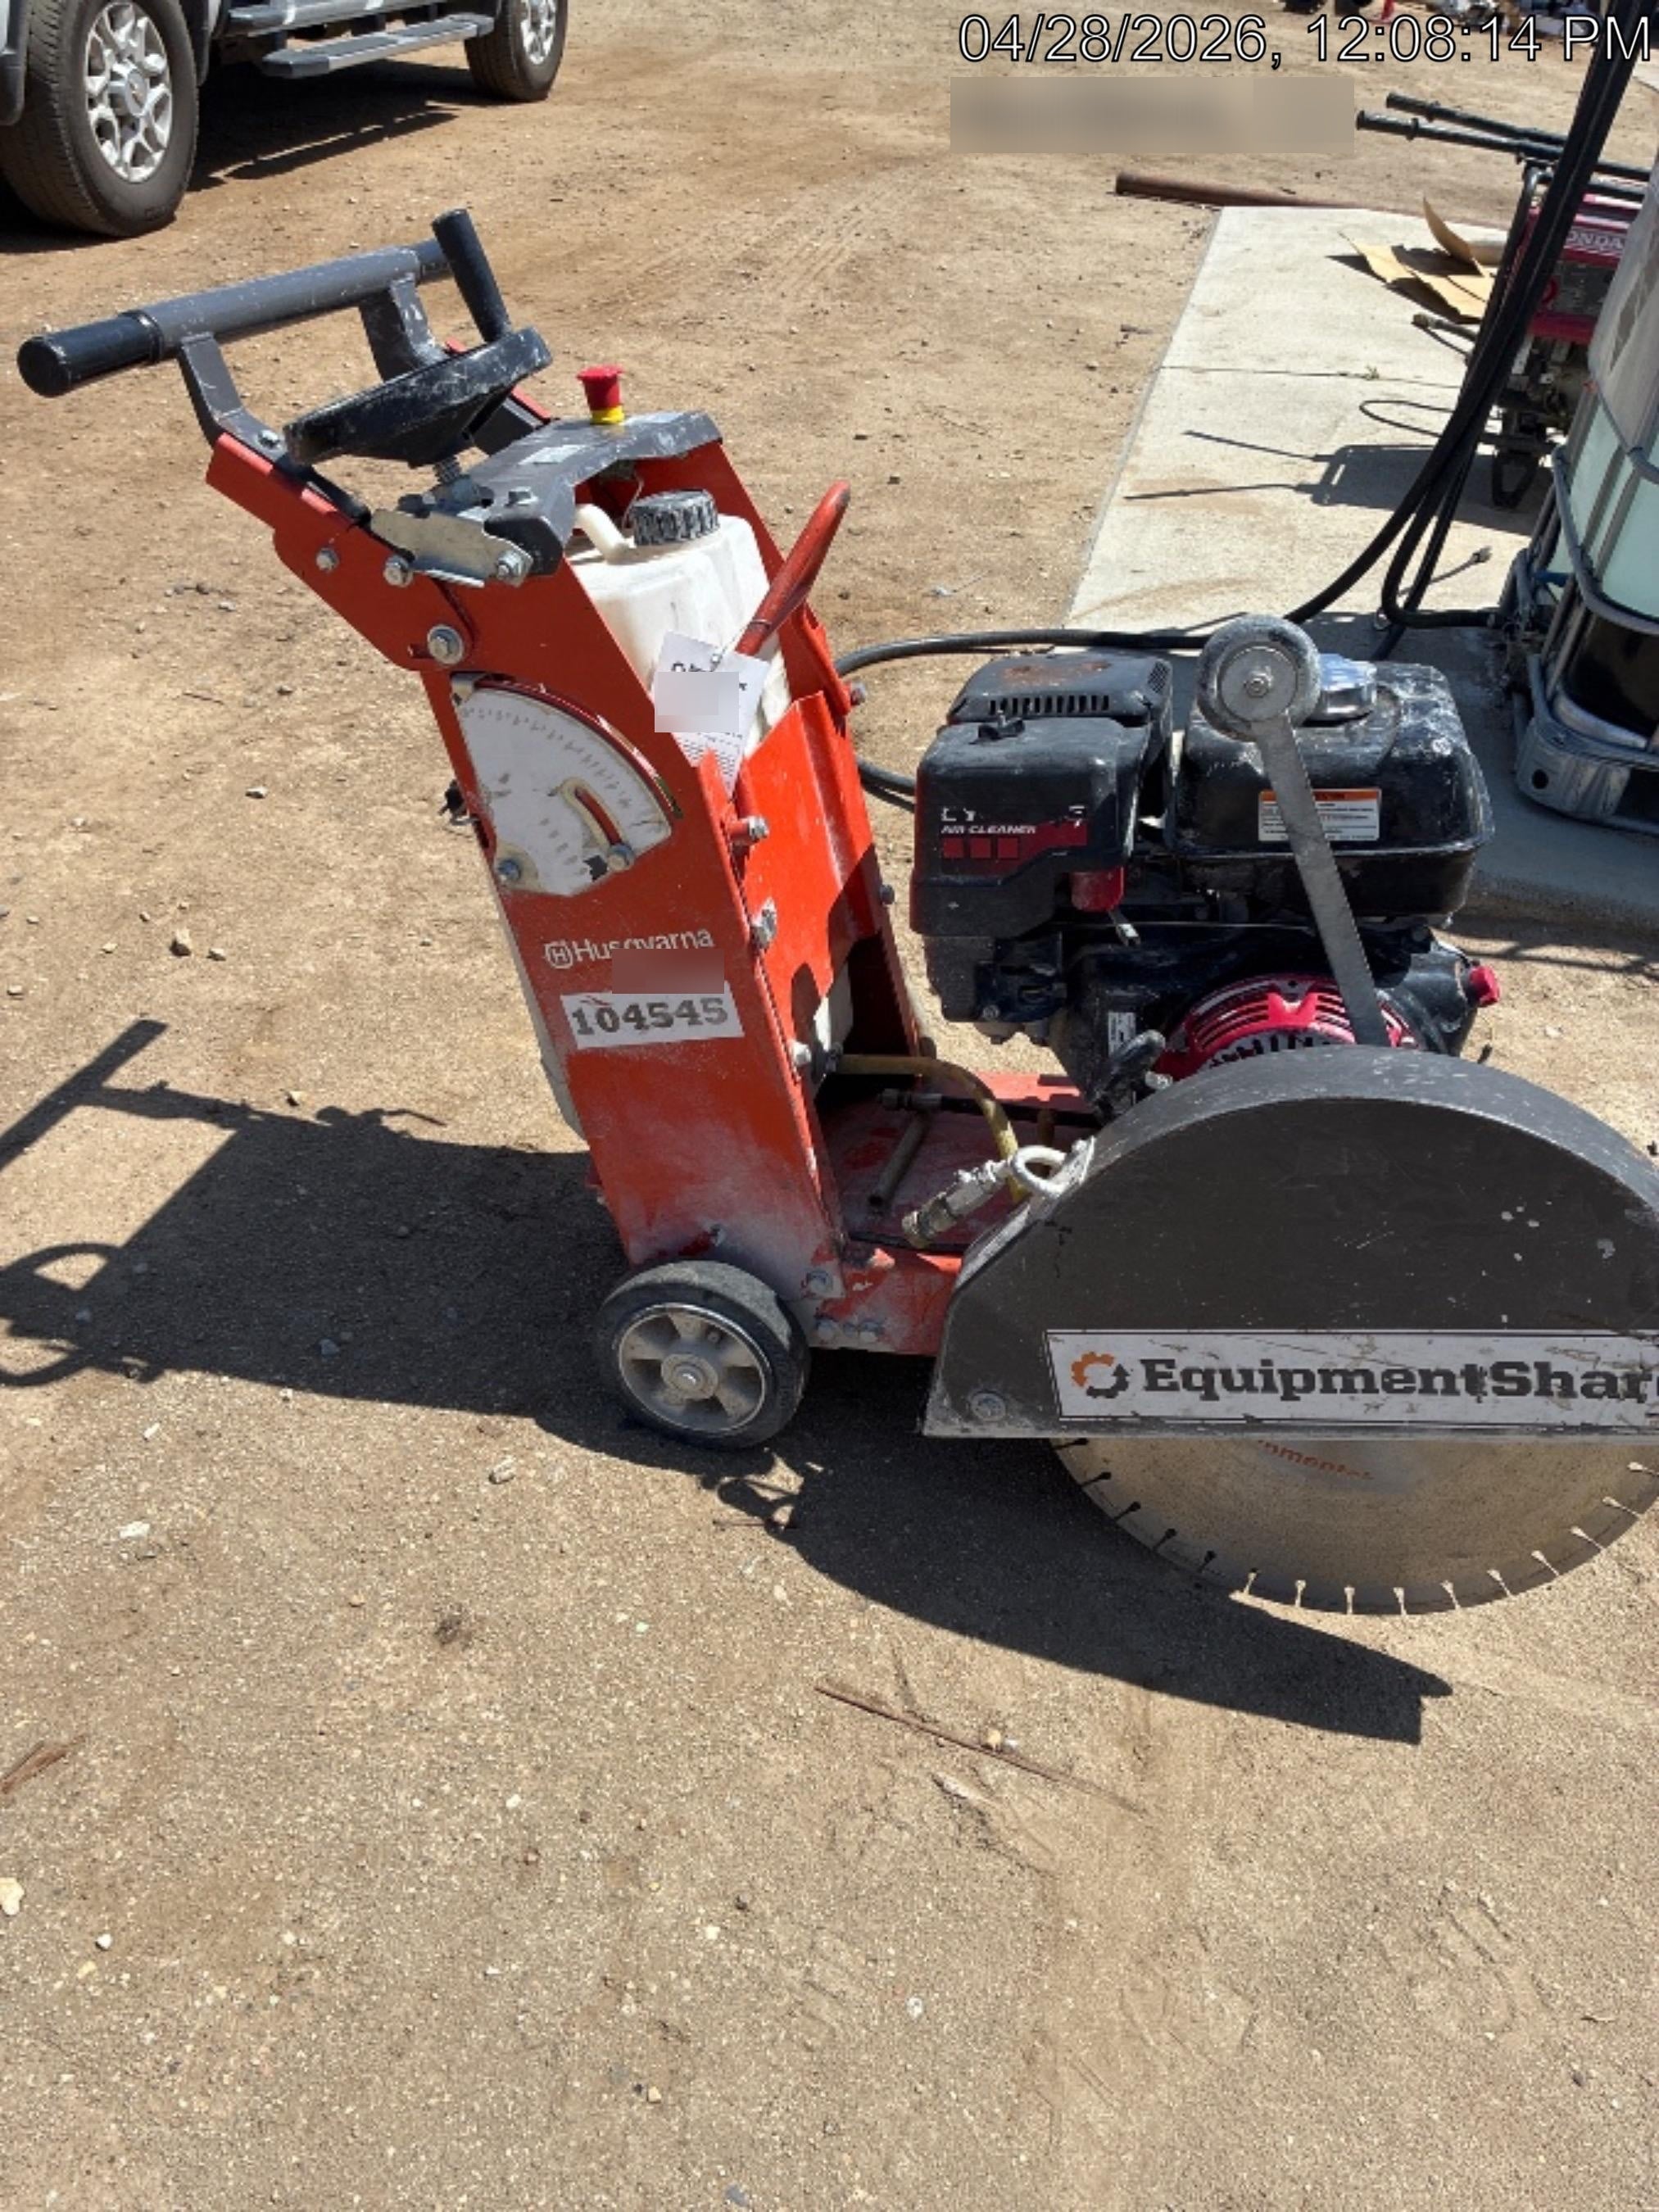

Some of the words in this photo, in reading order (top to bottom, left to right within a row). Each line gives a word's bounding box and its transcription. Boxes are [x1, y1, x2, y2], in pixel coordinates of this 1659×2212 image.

[1566, 230, 1624, 250] ONDA
[572, 997, 728, 1036] 104545
[1140, 1358, 1659, 1403] EquipmentShar
